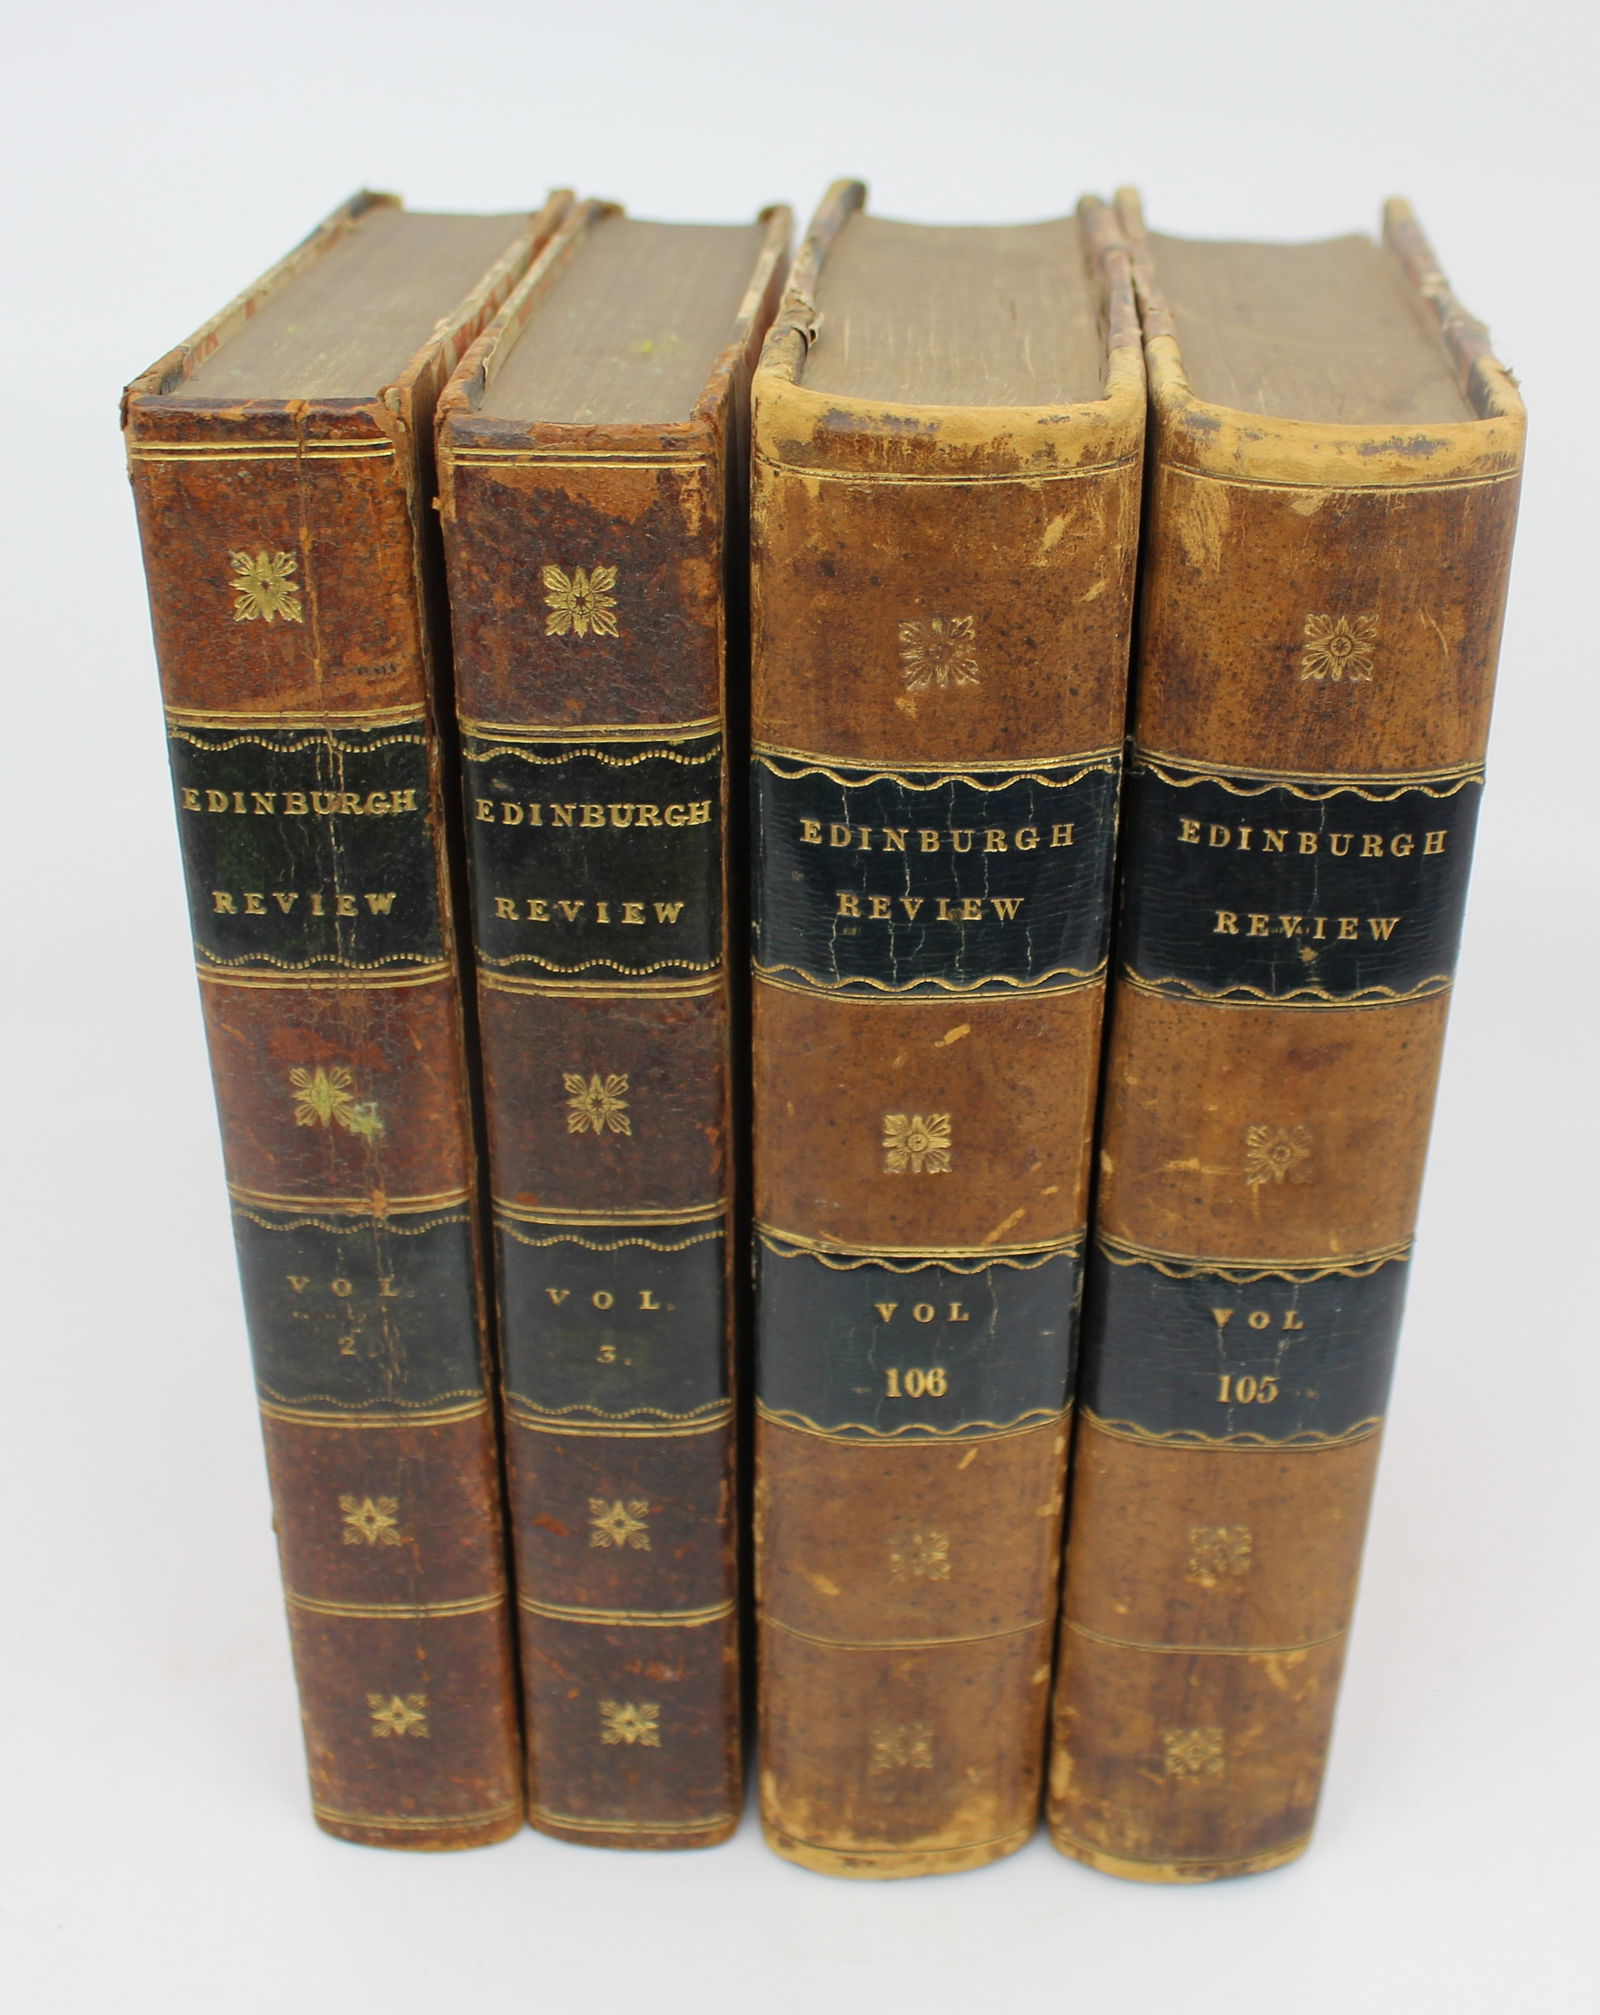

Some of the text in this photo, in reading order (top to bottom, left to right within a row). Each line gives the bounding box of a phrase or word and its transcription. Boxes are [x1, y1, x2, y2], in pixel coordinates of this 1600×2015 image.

[182, 787, 418, 816] EDINBURGH
[475, 798, 713, 829] EDINBURGH
[800, 818, 1075, 854] EDINBURGH
[1178, 818, 1450, 858] EDINBURGH
[212, 891, 397, 917] REVIEW
[494, 896, 685, 925] REVIEW
[836, 892, 1026, 923] REVIEW
[1213, 911, 1401, 942] REVIEW
[874, 1302, 970, 1324] VOL
[1212, 1307, 1304, 1331] VOL
[884, 1367, 949, 1400] 106
[1215, 1374, 1280, 1405] 105
